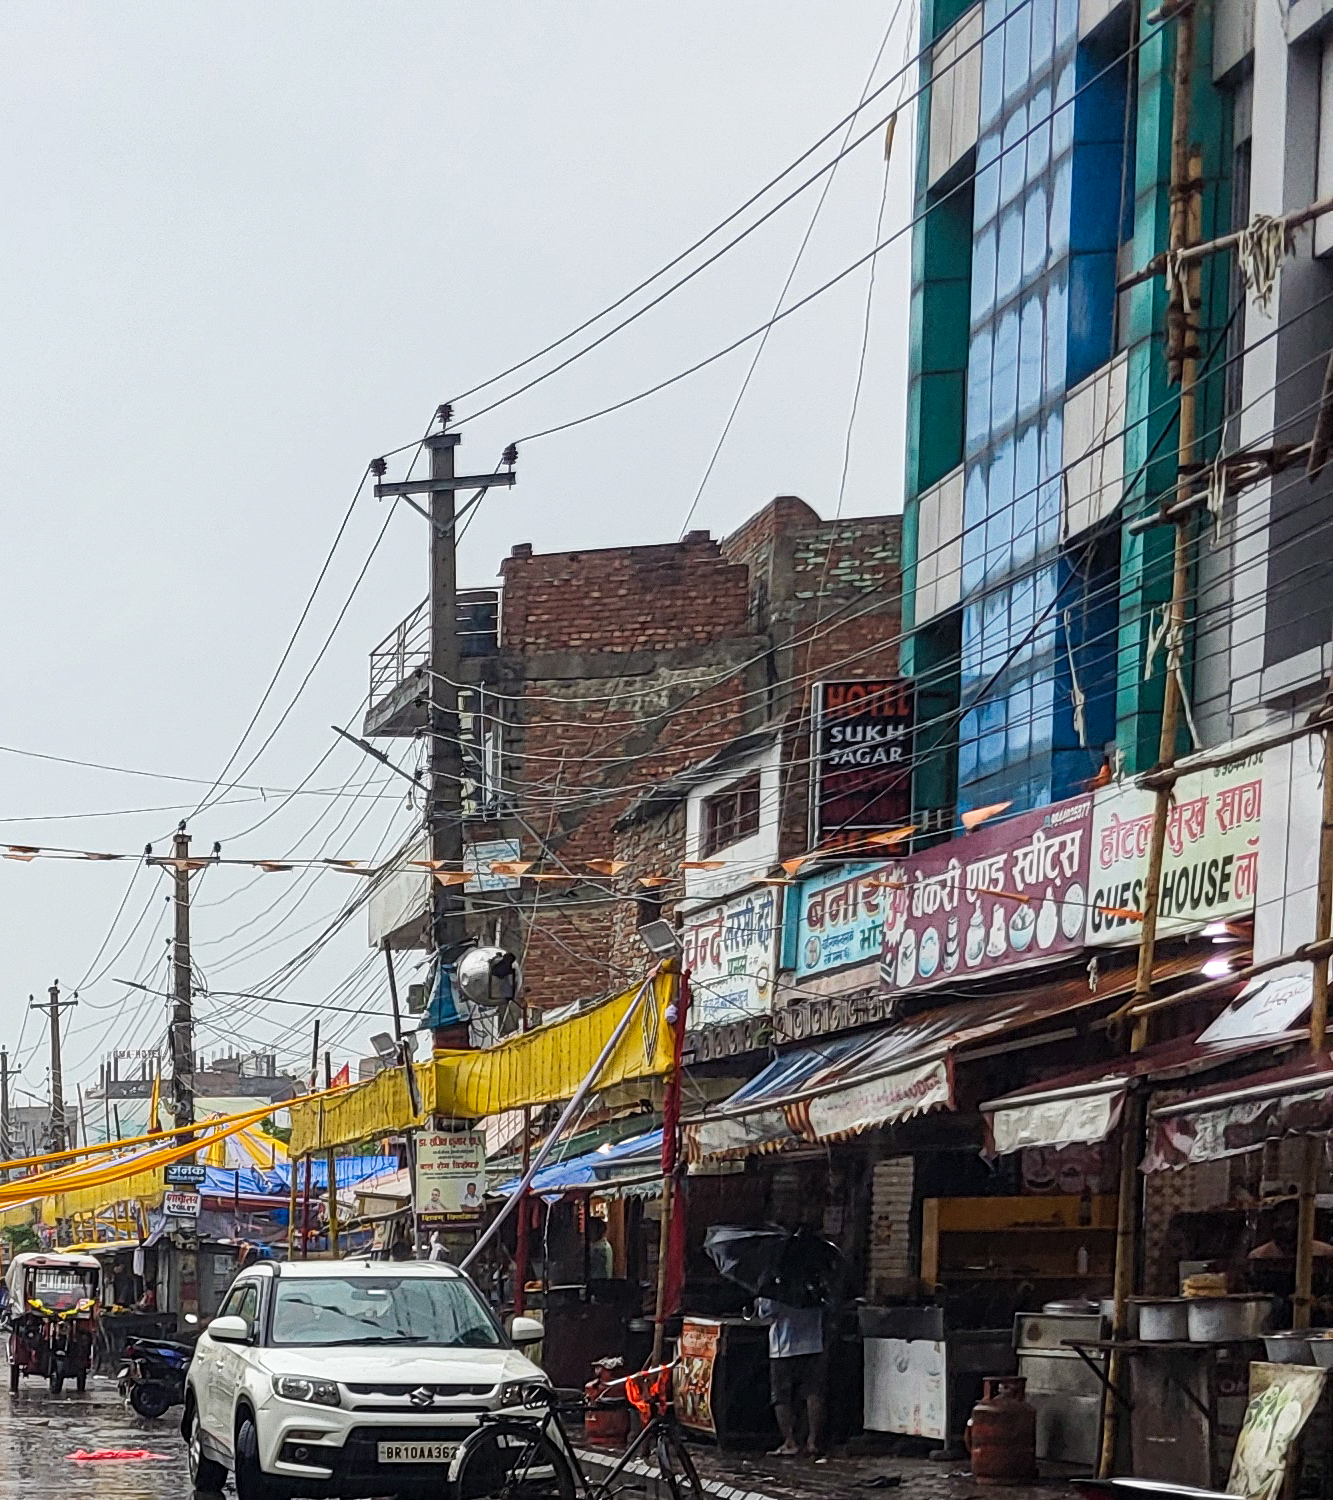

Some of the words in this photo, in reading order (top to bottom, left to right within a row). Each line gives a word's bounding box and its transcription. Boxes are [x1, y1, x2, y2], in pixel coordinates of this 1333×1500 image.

[827, 683, 910, 717] HOTEL
[830, 724, 906, 743] SUKH
[829, 746, 903, 765] SAGAR
[1166, 797, 1210, 857] सुख
[912, 858, 962, 918] बेकरी
[1012, 829, 1084, 891] स्वीट्स
[1091, 878, 1148, 933] GUES
[1160, 854, 1234, 917] HOUSE
[168, 1166, 205, 1175] जनक
